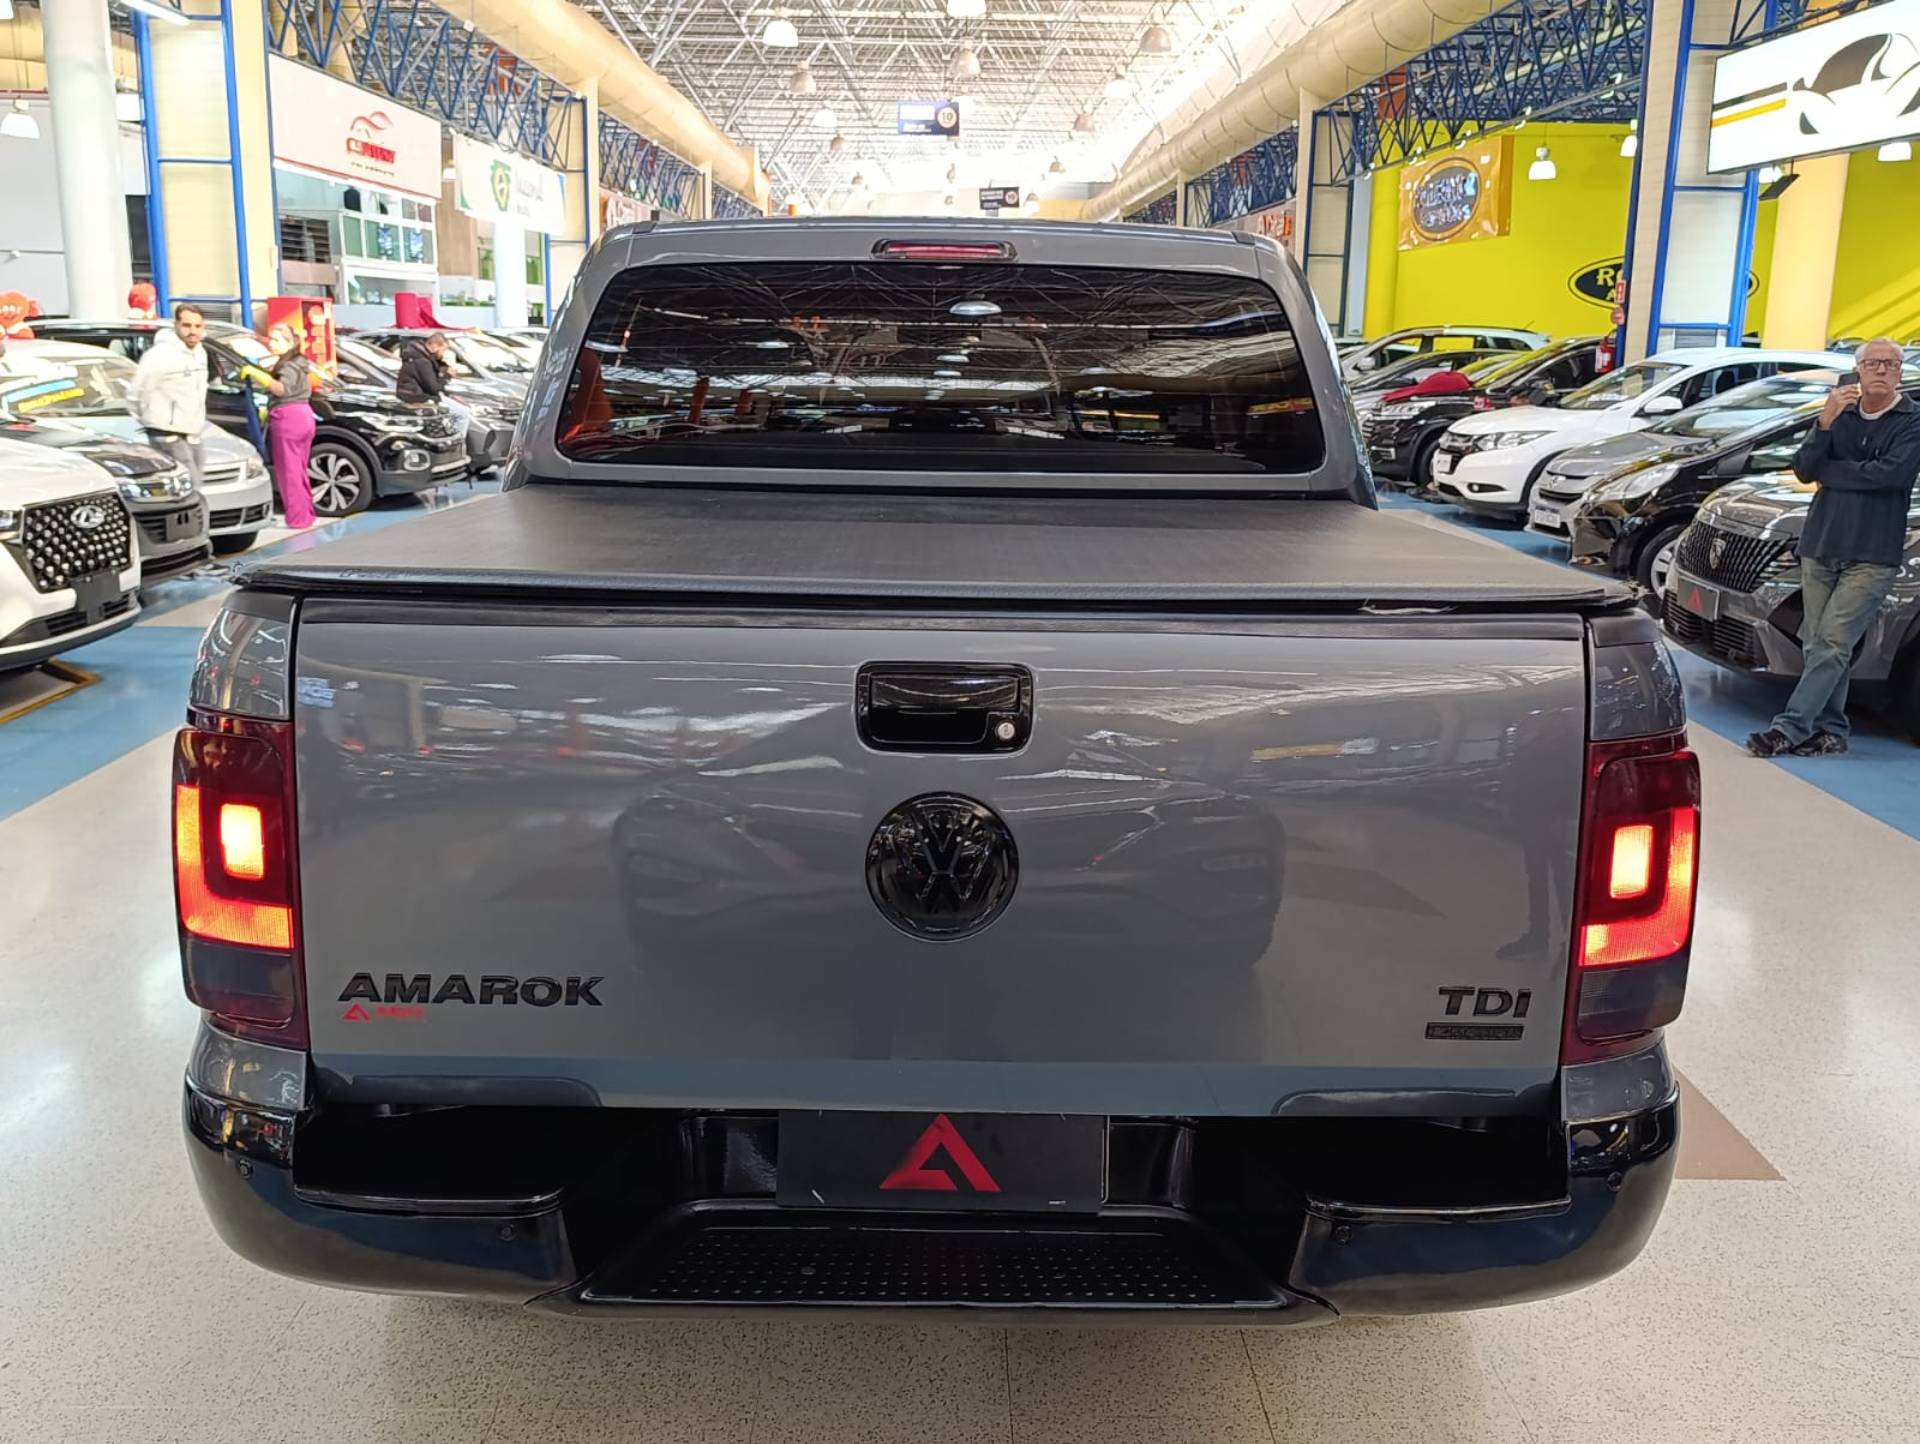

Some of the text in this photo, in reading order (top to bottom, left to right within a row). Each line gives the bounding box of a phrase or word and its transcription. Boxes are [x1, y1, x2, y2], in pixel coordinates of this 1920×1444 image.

[942, 111, 954, 122] 10
[337, 972, 604, 1007] AMAROK
[1438, 986, 1532, 1018] TDI
